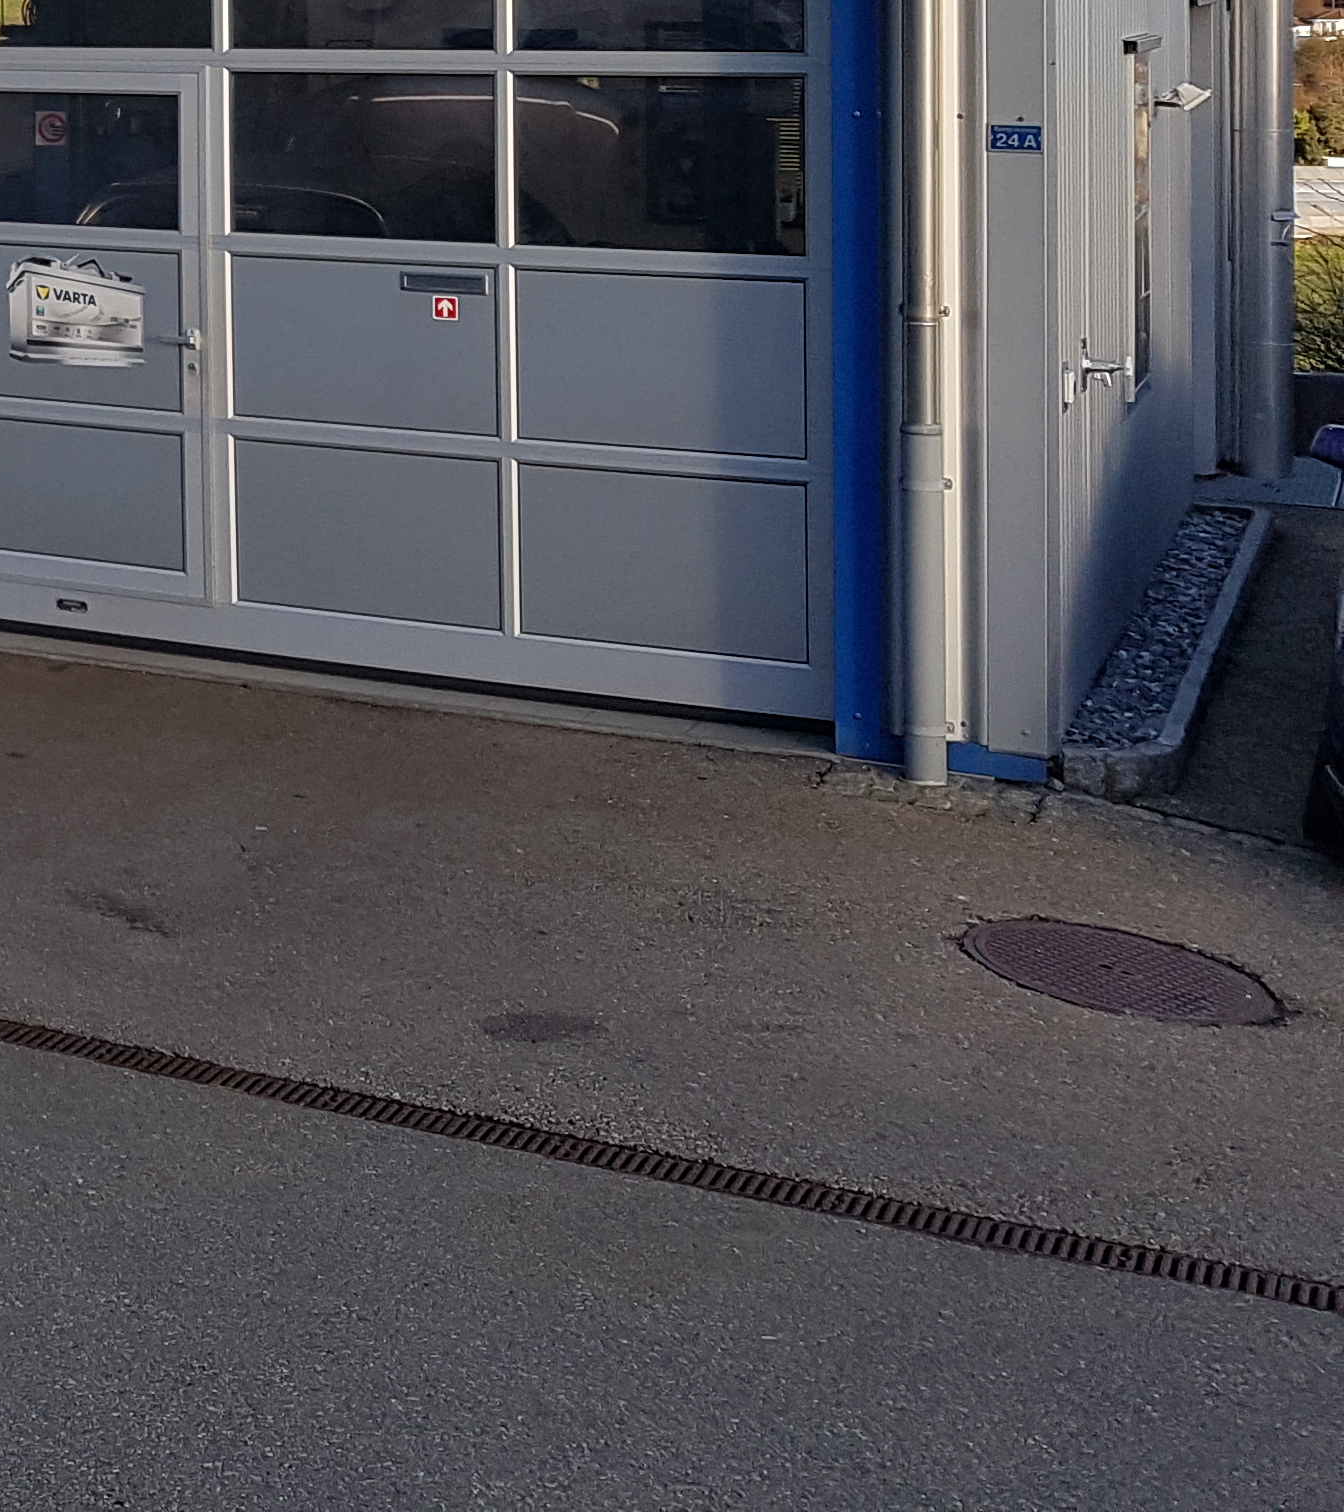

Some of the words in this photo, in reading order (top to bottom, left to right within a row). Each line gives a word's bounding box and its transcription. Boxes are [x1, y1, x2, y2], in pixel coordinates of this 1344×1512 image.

[995, 133, 1020, 148] 24
[1023, 134, 1037, 148] A
[53, 287, 97, 307] VARTA
